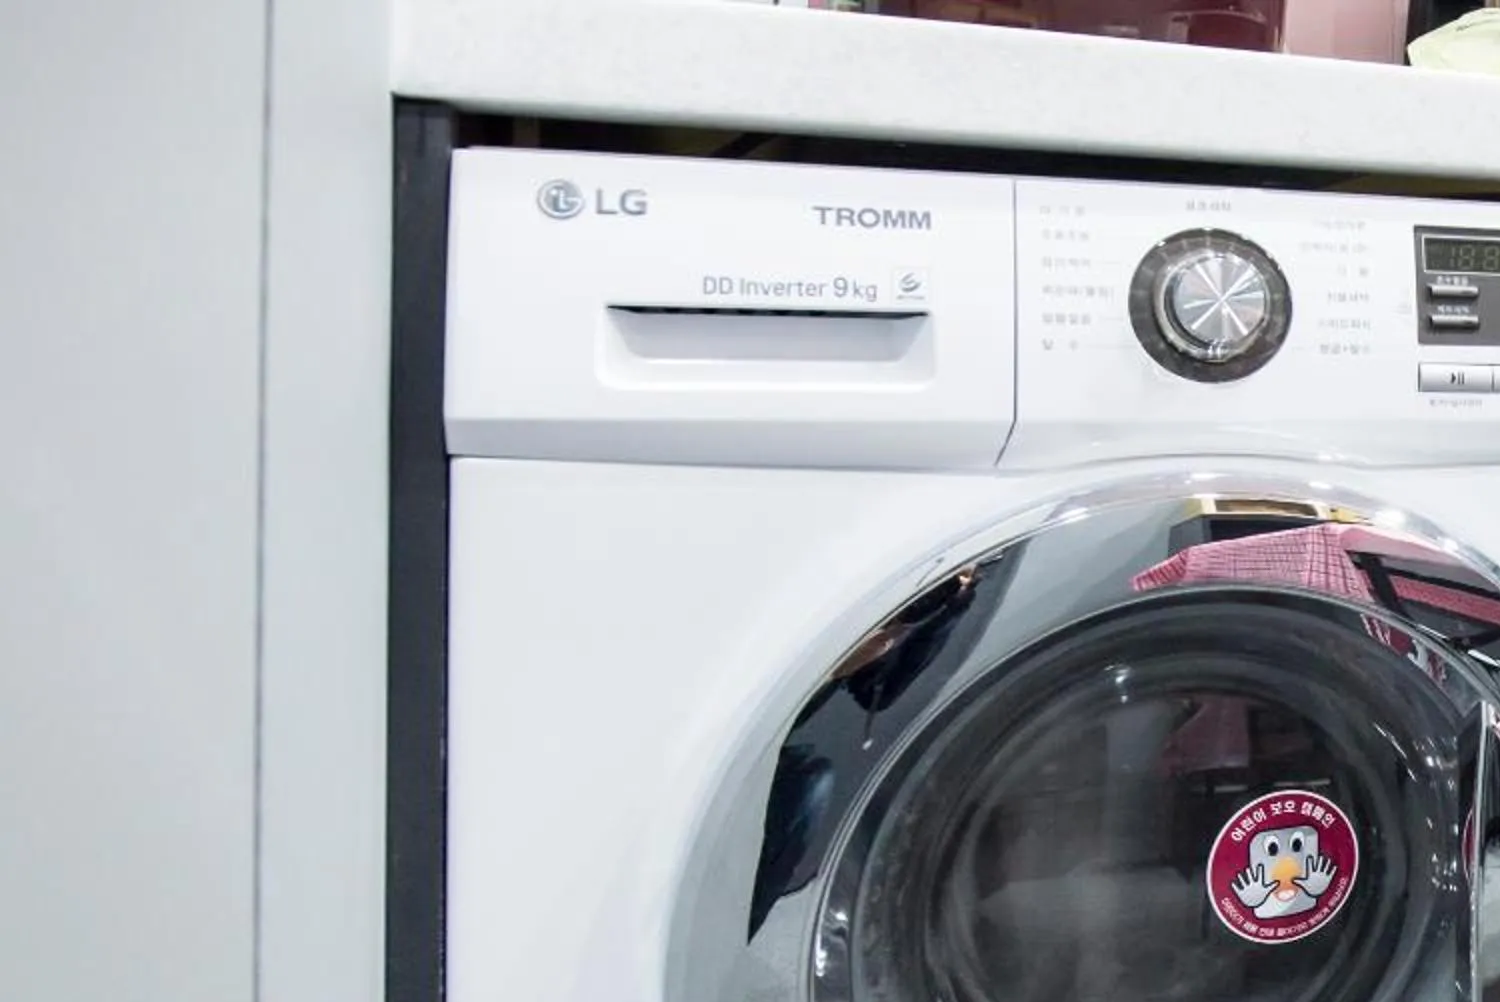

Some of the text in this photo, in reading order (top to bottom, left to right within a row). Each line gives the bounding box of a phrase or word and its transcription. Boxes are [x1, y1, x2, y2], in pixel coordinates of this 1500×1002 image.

[595, 188, 648, 217] LG
[811, 205, 932, 231] TROMM
[702, 274, 734, 297] DD
[738, 276, 826, 300] Inverter
[1231, 808, 1267, 842] 어린이
